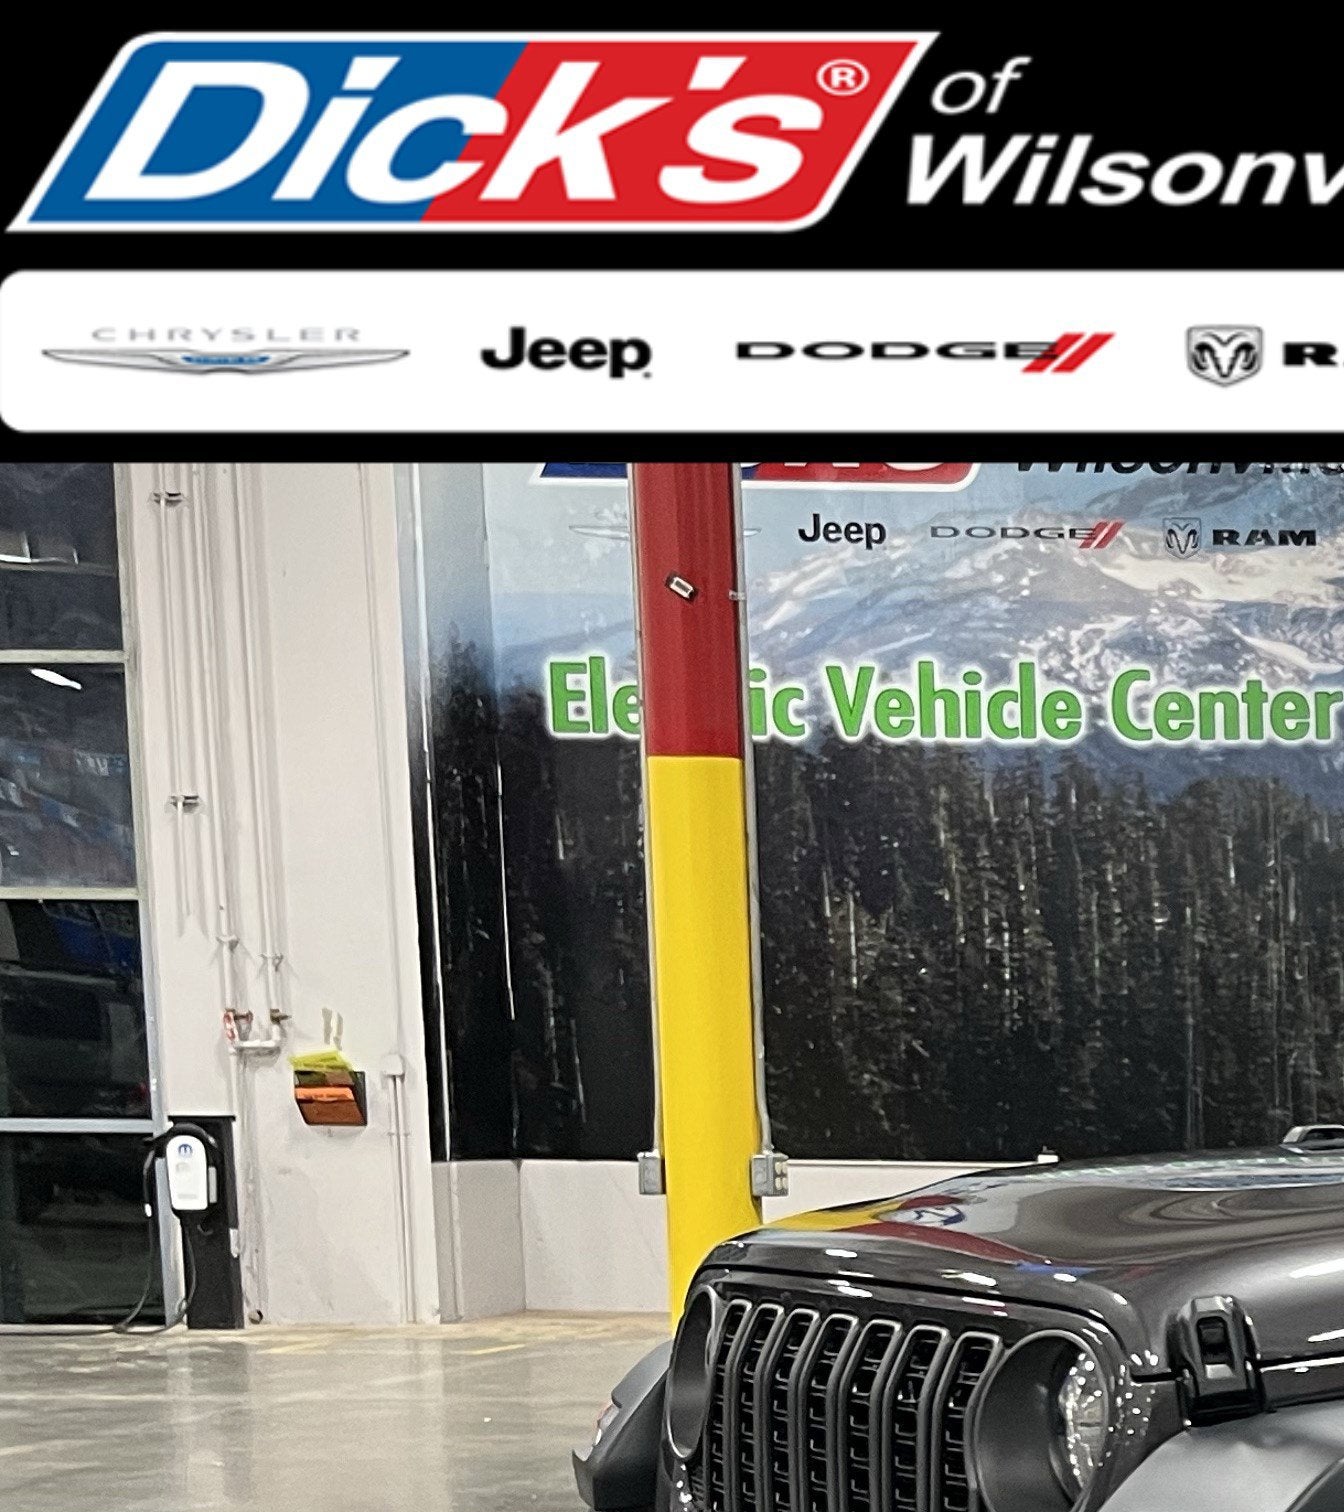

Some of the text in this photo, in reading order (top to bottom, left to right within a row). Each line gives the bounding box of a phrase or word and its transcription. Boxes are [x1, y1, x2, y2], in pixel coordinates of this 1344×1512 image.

[797, 513, 887, 550] Jeep
[929, 526, 1096, 540] DODGE
[1212, 529, 1317, 547] RAM
[549, 655, 1344, 741] Eleic Vehicle Center
